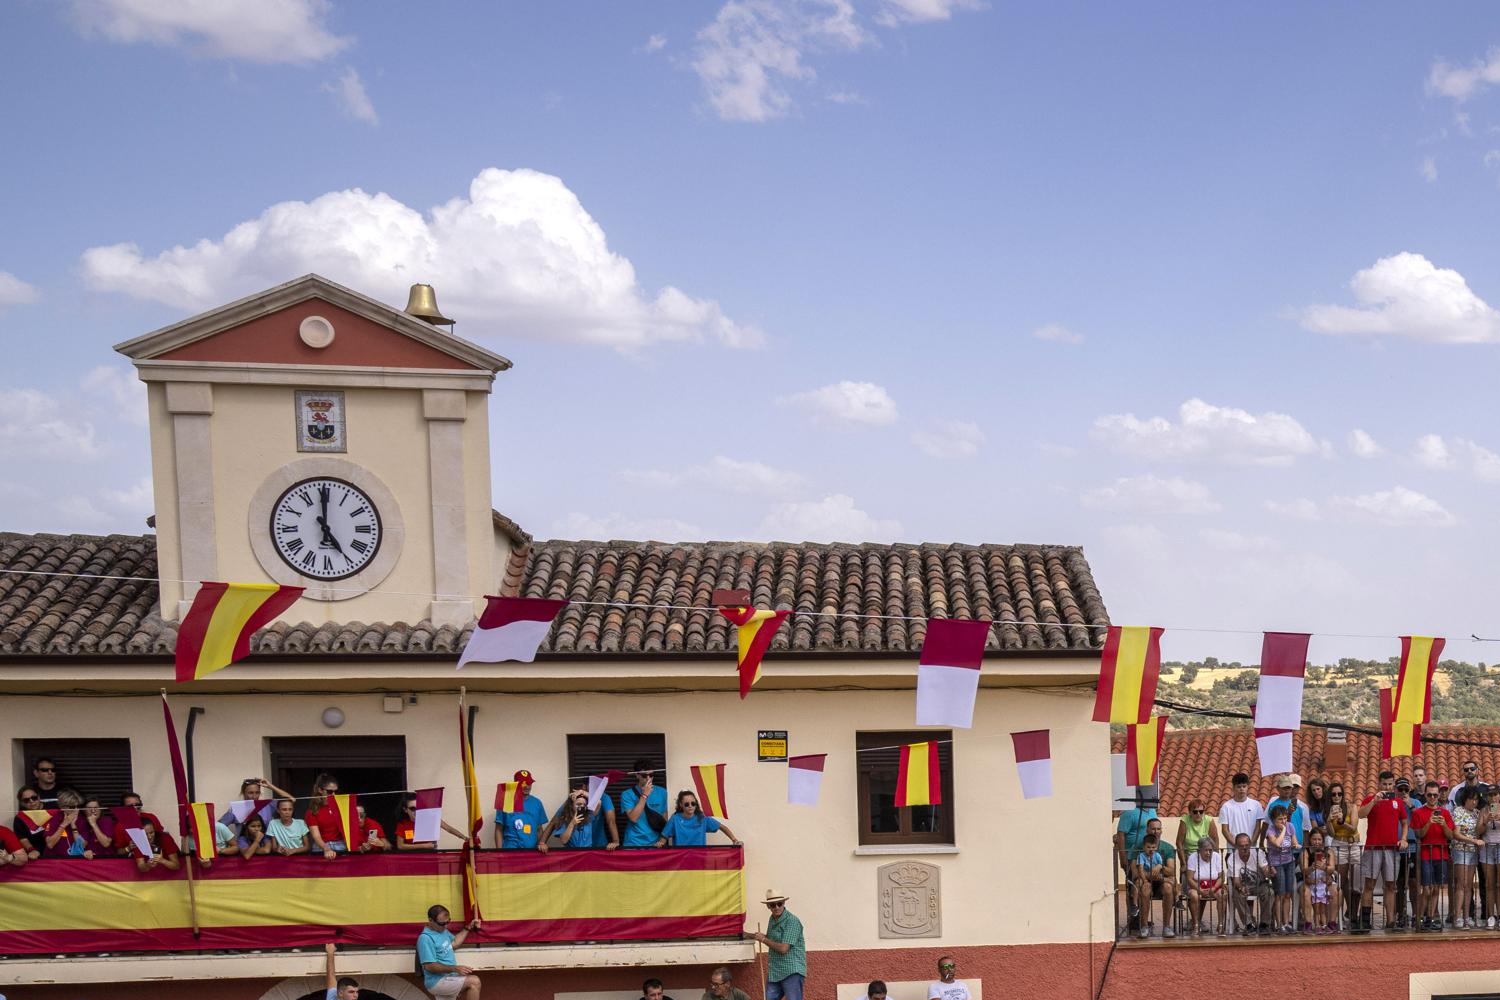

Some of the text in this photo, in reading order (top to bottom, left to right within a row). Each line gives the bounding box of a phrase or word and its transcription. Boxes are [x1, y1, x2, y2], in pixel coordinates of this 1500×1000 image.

[299, 491, 314, 507] XI
[339, 492, 350, 507] I
[286, 505, 302, 517] X
[350, 506, 366, 518] II
[355, 525, 371, 534] III
[323, 555, 334, 570] VI
